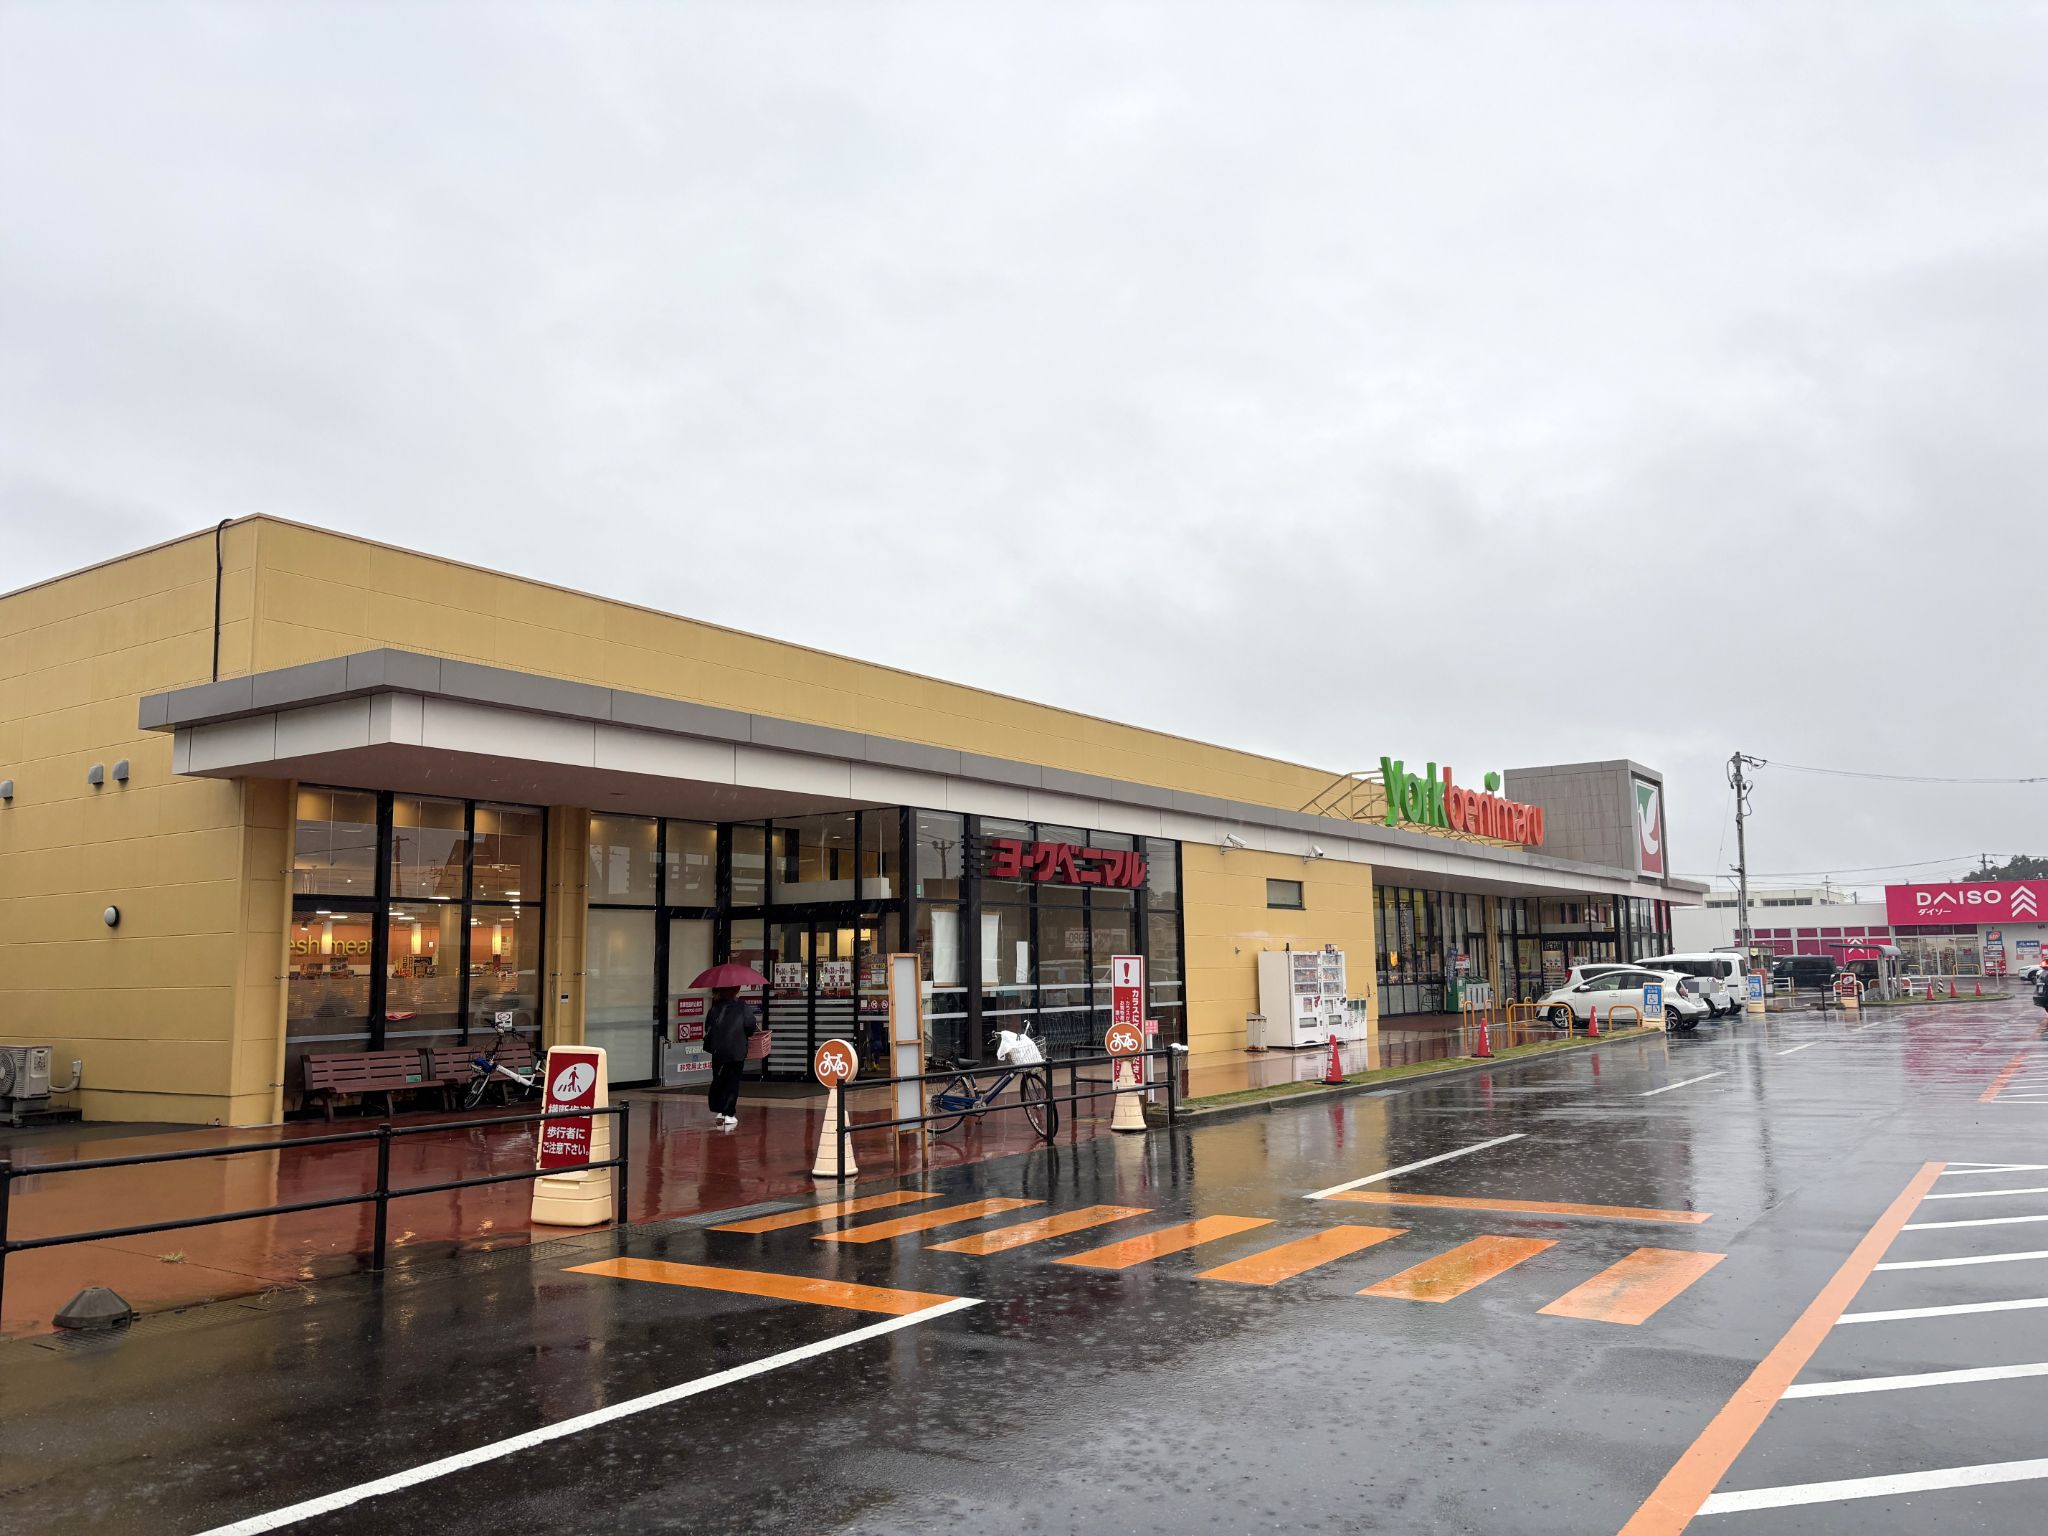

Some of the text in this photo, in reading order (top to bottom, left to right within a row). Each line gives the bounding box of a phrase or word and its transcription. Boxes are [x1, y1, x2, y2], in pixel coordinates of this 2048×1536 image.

[988, 838, 1148, 888] ヨークベニマル
[1916, 889, 2002, 906] DAISO
[1918, 908, 1952, 916] ダイソー
[547, 1126, 586, 1140] 歩行者に
